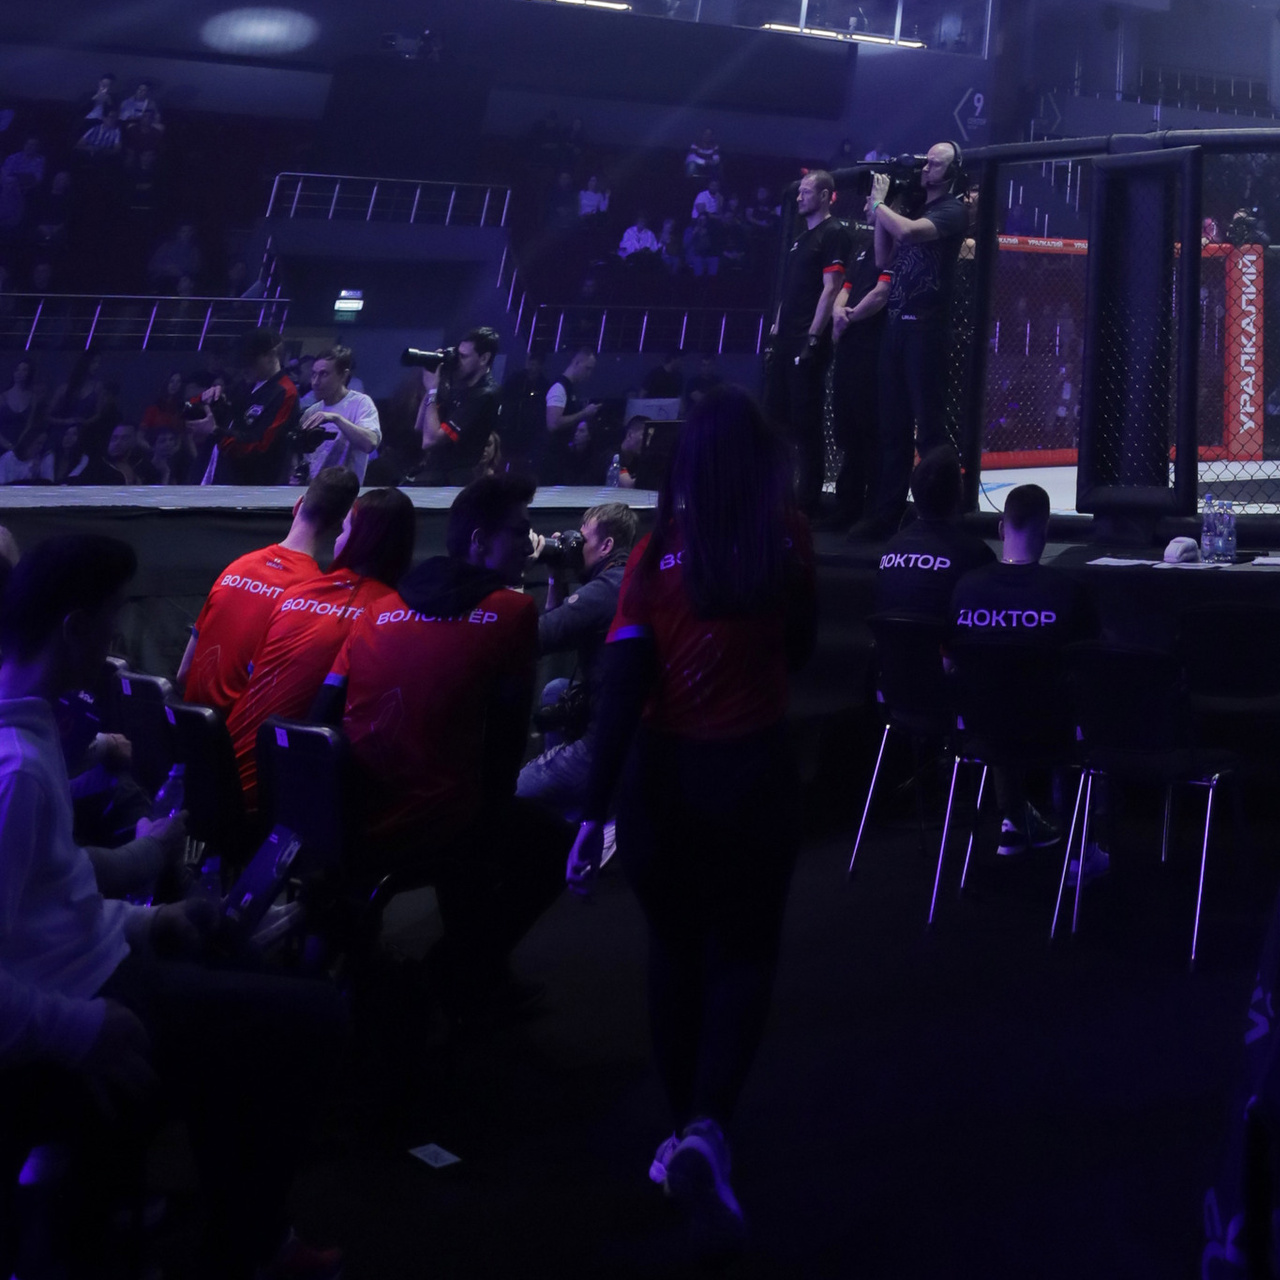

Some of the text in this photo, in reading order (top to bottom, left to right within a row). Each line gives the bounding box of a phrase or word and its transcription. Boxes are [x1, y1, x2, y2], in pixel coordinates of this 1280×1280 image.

[973, 92, 984, 117] 9
[1238, 252, 1258, 435] УРАЛКАЛИЙ
[878, 552, 952, 572] ДОКТОР
[220, 573, 285, 600] ВОЛОНТ
[956, 608, 1057, 628] ДОКТОР
